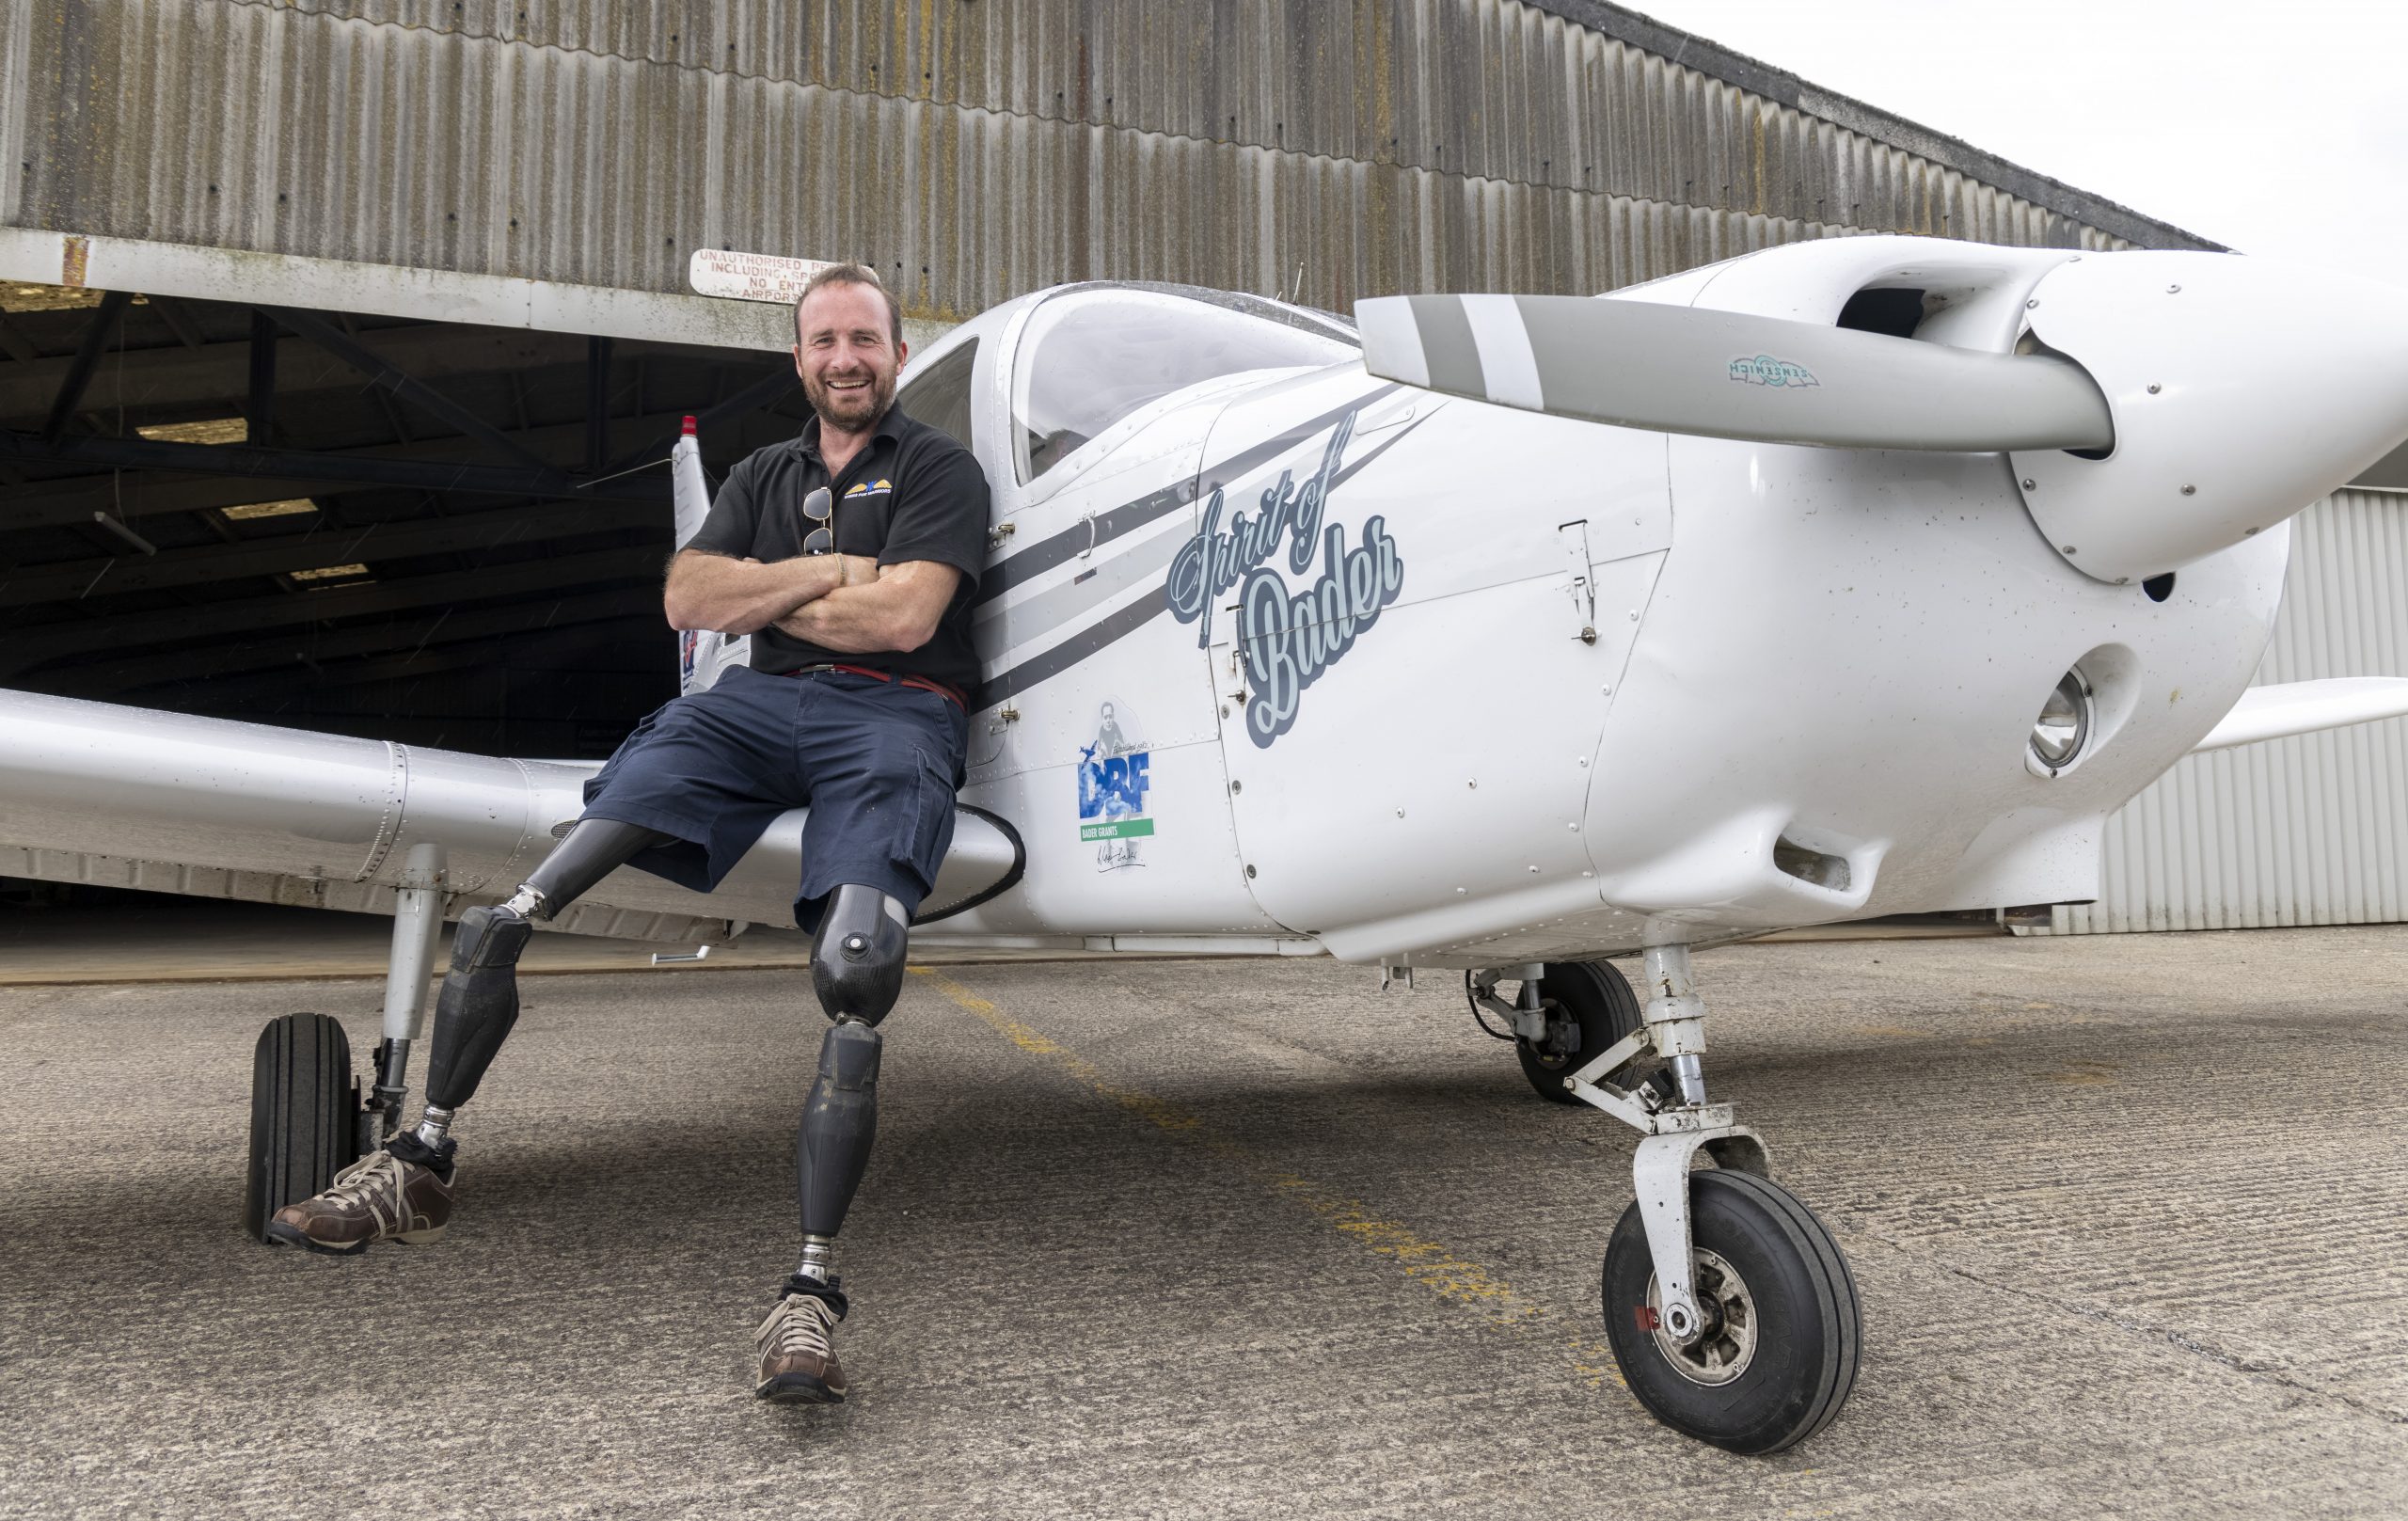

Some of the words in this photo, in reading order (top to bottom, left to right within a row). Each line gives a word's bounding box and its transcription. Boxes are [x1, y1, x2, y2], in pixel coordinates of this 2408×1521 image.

[700, 250, 801, 270] UNAUTHORISED
[711, 261, 781, 278] INCLUDING
[791, 271, 816, 280] SPO
[750, 277, 767, 288] NO
[779, 280, 804, 291] ENT
[1730, 364, 1808, 378] SENSENICH
[1166, 469, 1294, 649] Spirit
[1290, 410, 1357, 575] of
[1239, 515, 1403, 749] Bader
[1078, 753, 1149, 818] DRF
[1082, 827, 1098, 839] BADER
[1098, 825, 1118, 837] GRANTS
